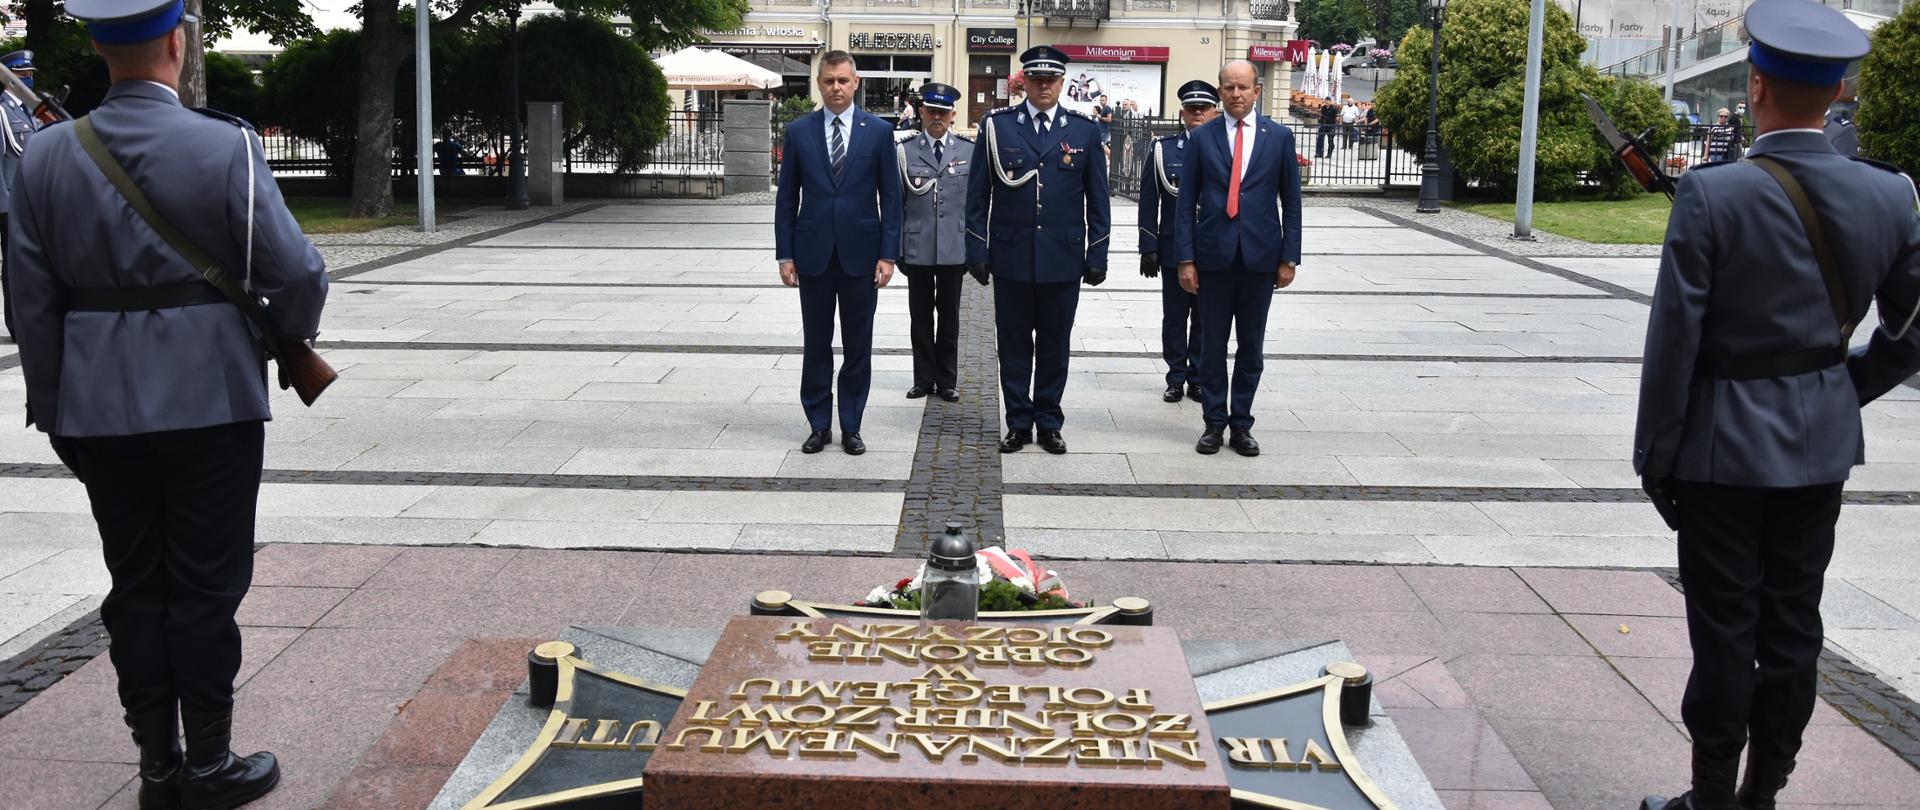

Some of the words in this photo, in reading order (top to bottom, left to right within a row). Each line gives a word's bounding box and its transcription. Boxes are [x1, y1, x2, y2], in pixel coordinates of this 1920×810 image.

[766, 26, 805, 37] włoska
[1619, 23, 1644, 32] Farby
[849, 32, 933, 49] MLECZNA
[971, 36, 986, 45] City
[988, 36, 1015, 46] College
[1200, 37, 1210, 45] 33
[1085, 46, 1136, 56] Millennium
[1253, 46, 1284, 57] Millennium
[1291, 48, 1304, 63] M
[774, 622, 1114, 648] OJCZYZNY
[809, 641, 1093, 667] OBRONIE
[911, 664, 986, 685] W
[731, 678, 1154, 711] POLEGŁEMU
[665, 727, 1207, 767] NIEZNANEMU
[1219, 737, 1341, 772] VIR
